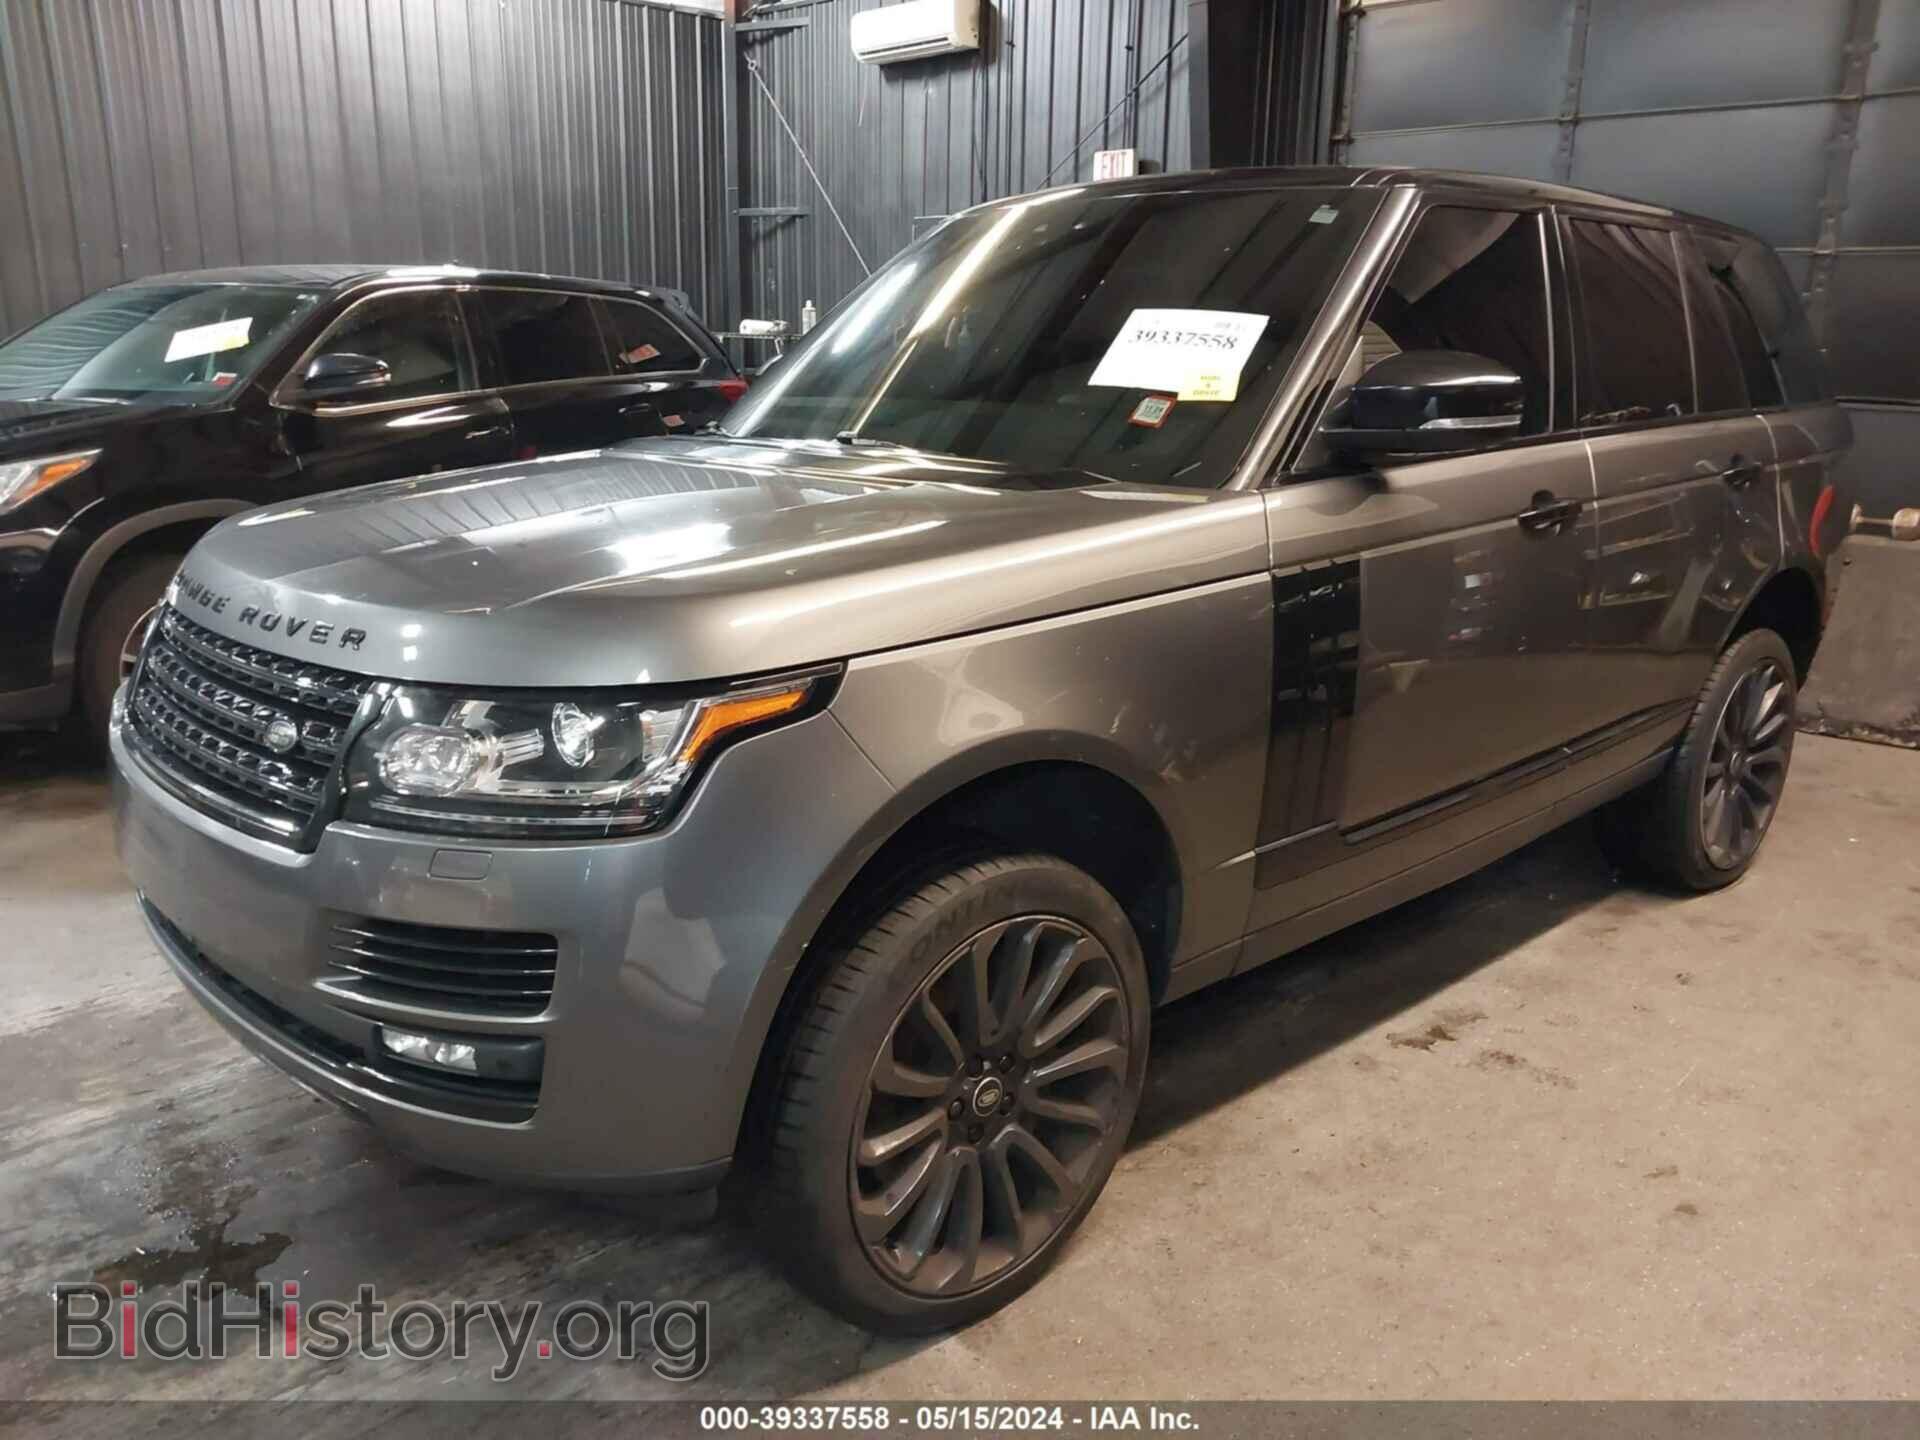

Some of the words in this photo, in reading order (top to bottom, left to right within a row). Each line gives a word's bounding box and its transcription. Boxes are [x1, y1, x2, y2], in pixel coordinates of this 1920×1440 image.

[1101, 151, 1128, 178] EXIT
[1128, 328, 1238, 350] 39337558
[238, 606, 367, 650] ROVER
